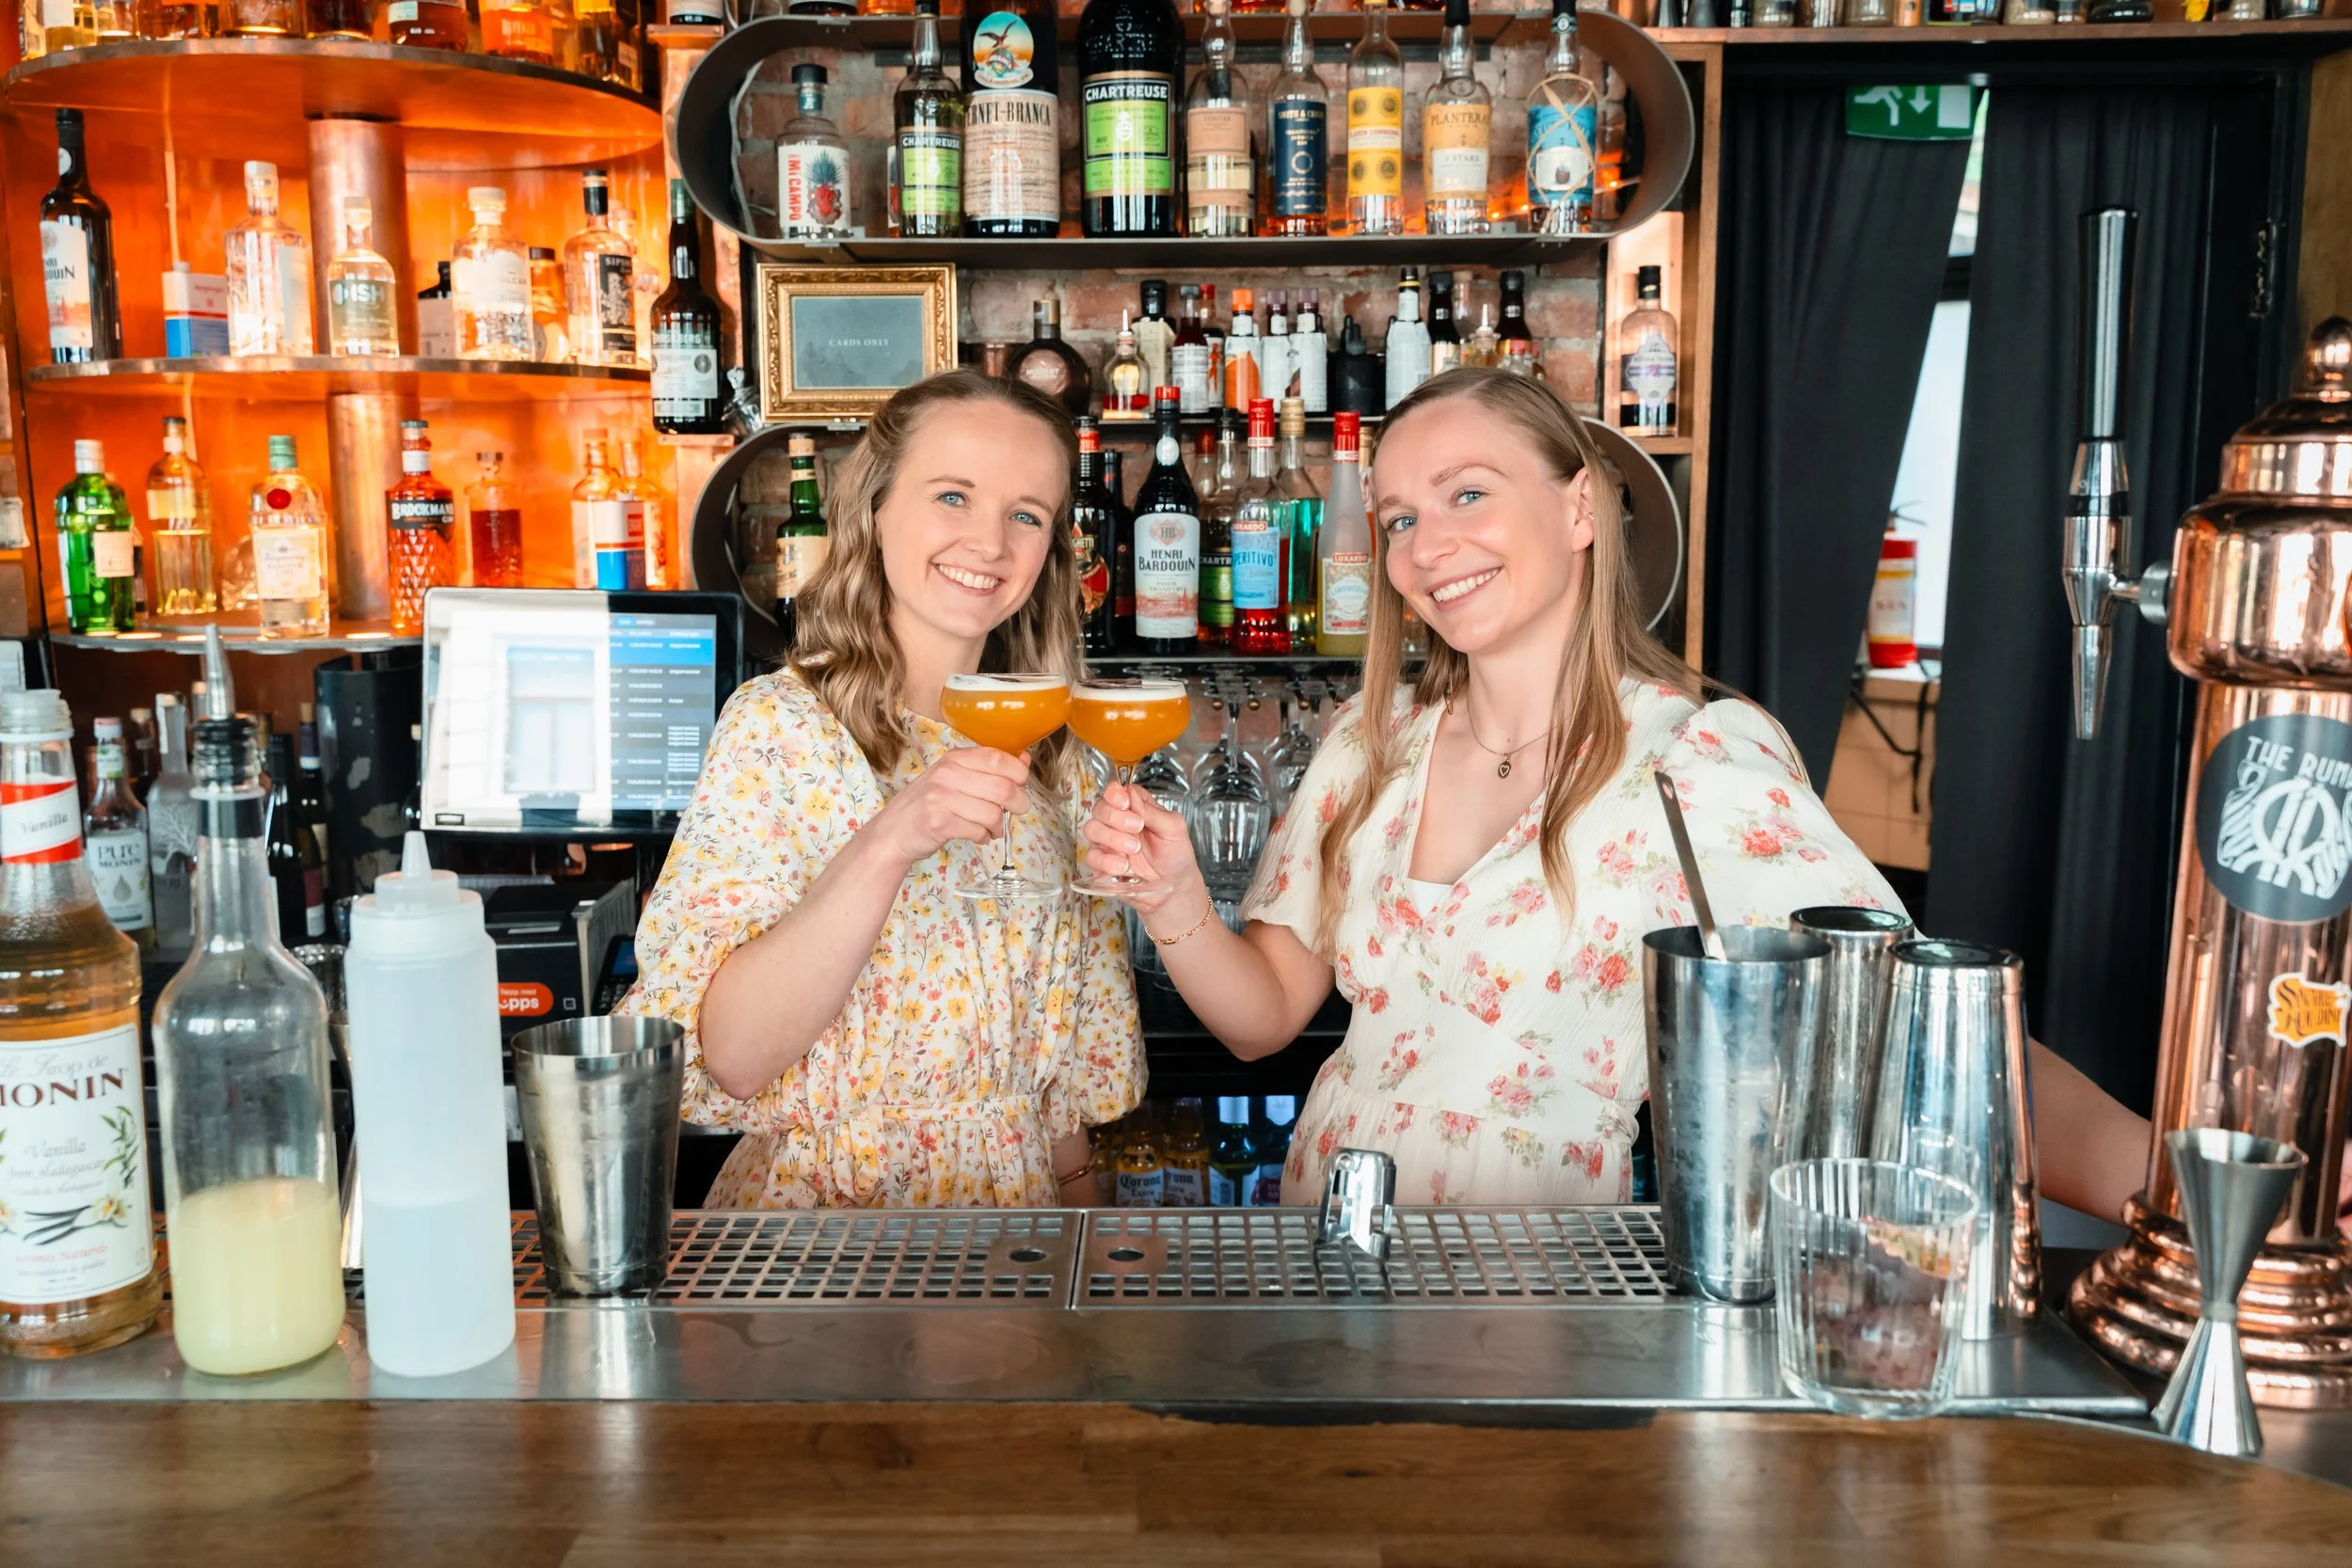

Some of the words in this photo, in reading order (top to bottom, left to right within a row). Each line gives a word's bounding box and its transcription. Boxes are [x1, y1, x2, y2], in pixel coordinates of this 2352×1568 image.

[1086, 85, 1168, 102] CHARTREUSE
[966, 101, 1051, 126] ERNET-BRANCA
[902, 136, 960, 150] CHARTREUSE
[788, 178, 803, 221] CAMPO
[829, 339, 862, 347] CARDS
[864, 339, 888, 347] ONLY
[391, 502, 453, 519] BROCKMAN
[1151, 548, 1183, 559] HENRI
[1200, 556, 1232, 565] CHARTR
[1232, 551, 1274, 566] PERITIVO
[1334, 554, 1367, 562] LUXARDO
[1138, 555, 1196, 572] BARDOUIN
[2246, 735, 2294, 772] THE
[22, 813, 69, 833] Vanilla
[87, 1054, 109, 1069] de
[24, 1137, 87, 1158] Vanilla
[39, 1159, 106, 1179] Madagascar
[1120, 1174, 1160, 1189] Corona
